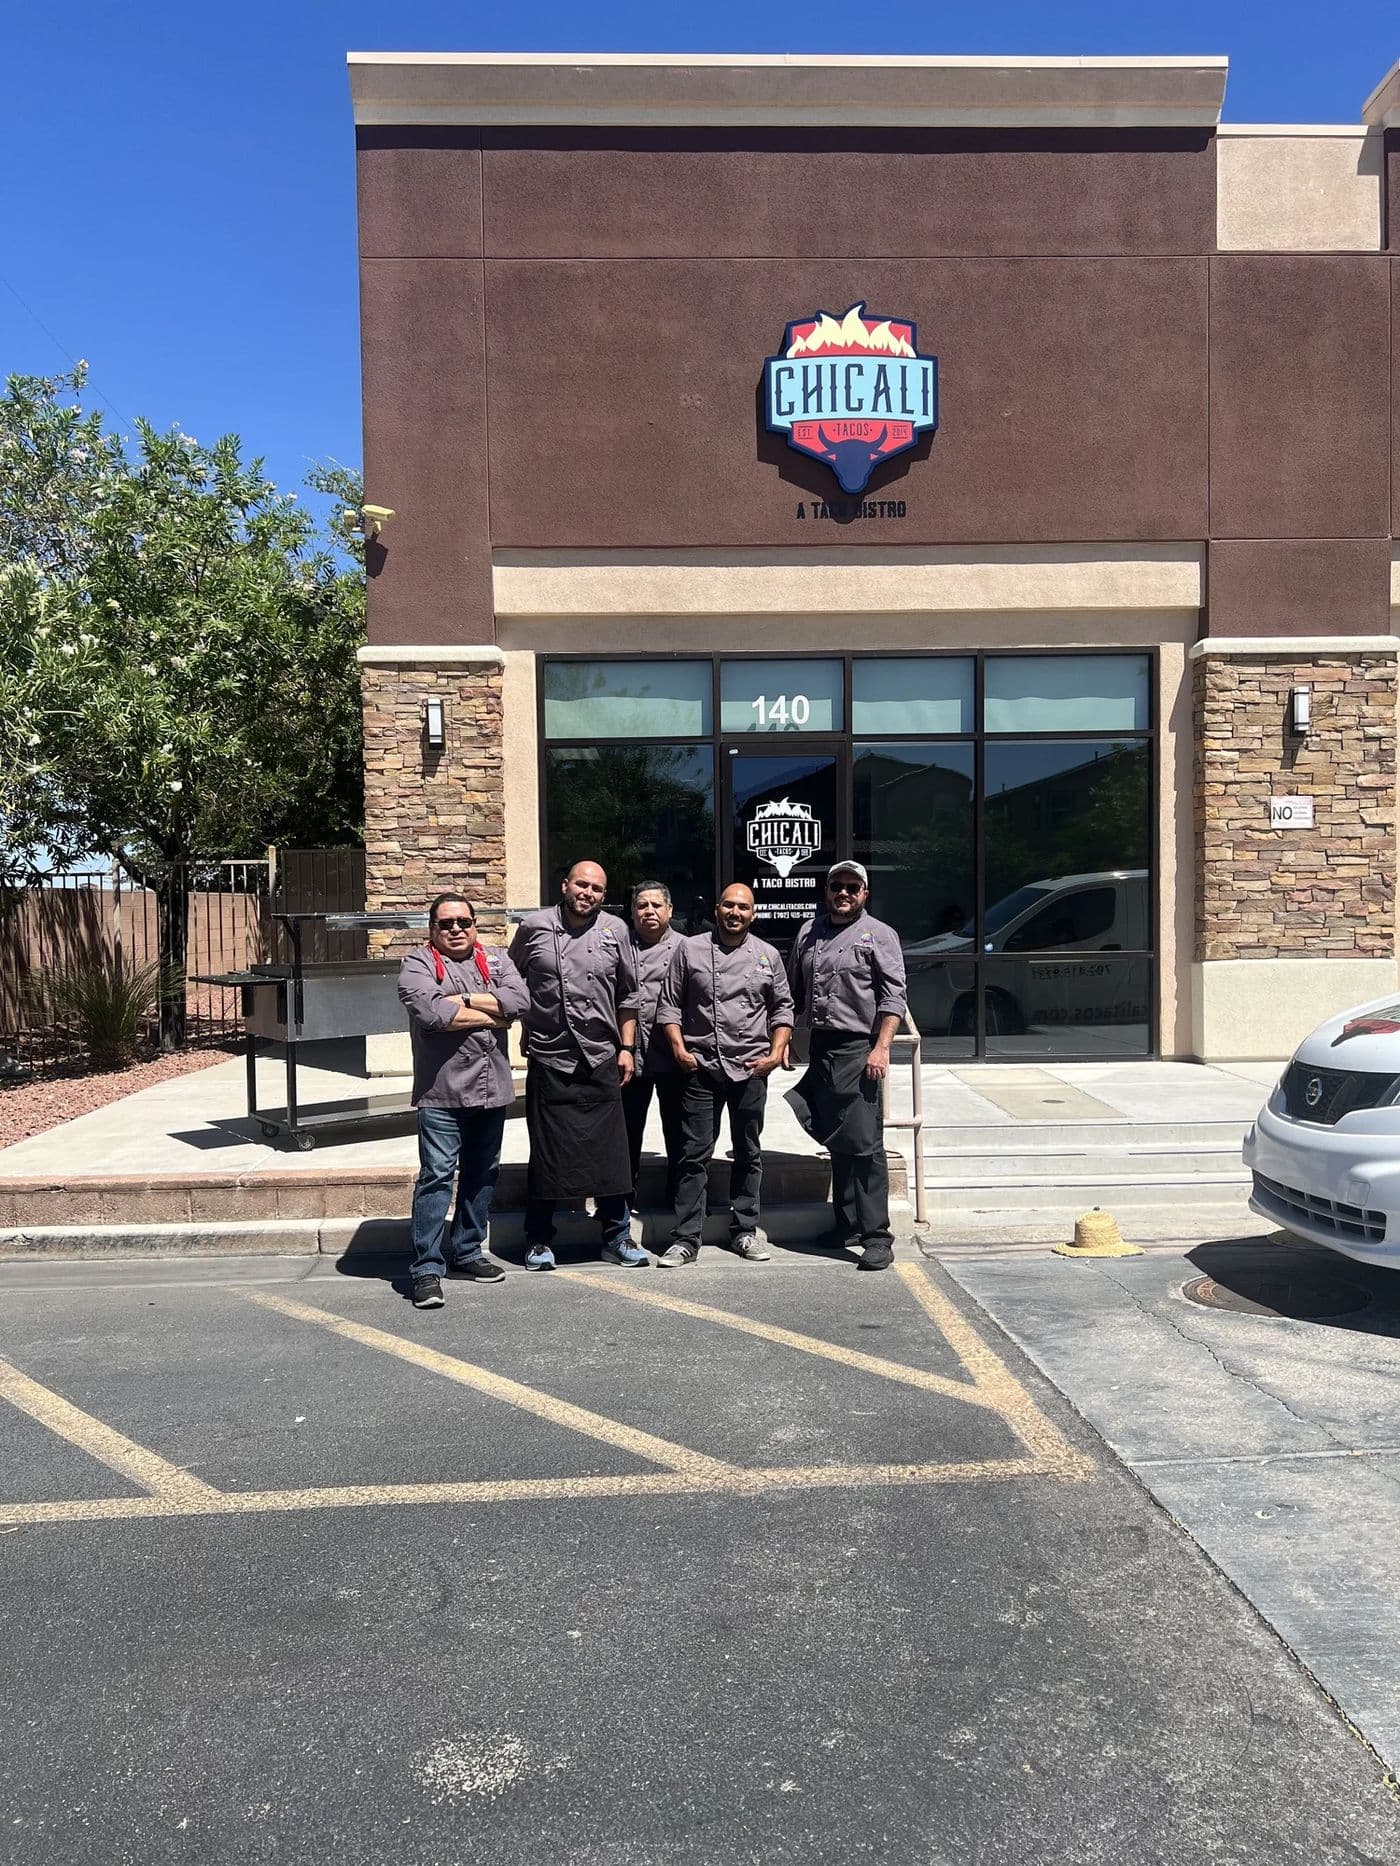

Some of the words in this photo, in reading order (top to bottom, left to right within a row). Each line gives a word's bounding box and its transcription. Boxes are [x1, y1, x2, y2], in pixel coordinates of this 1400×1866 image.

[775, 363, 929, 416] CHICALI
[798, 428, 811, 437] EST
[837, 423, 869, 437] TACOS
[796, 502, 806, 519] A
[751, 695, 810, 725] 140
[1272, 806, 1293, 820] NO
[749, 822, 818, 847] CHICALI
[753, 878, 759, 888] A
[761, 878, 783, 888] TACO
[785, 878, 816, 888] BISTRO
